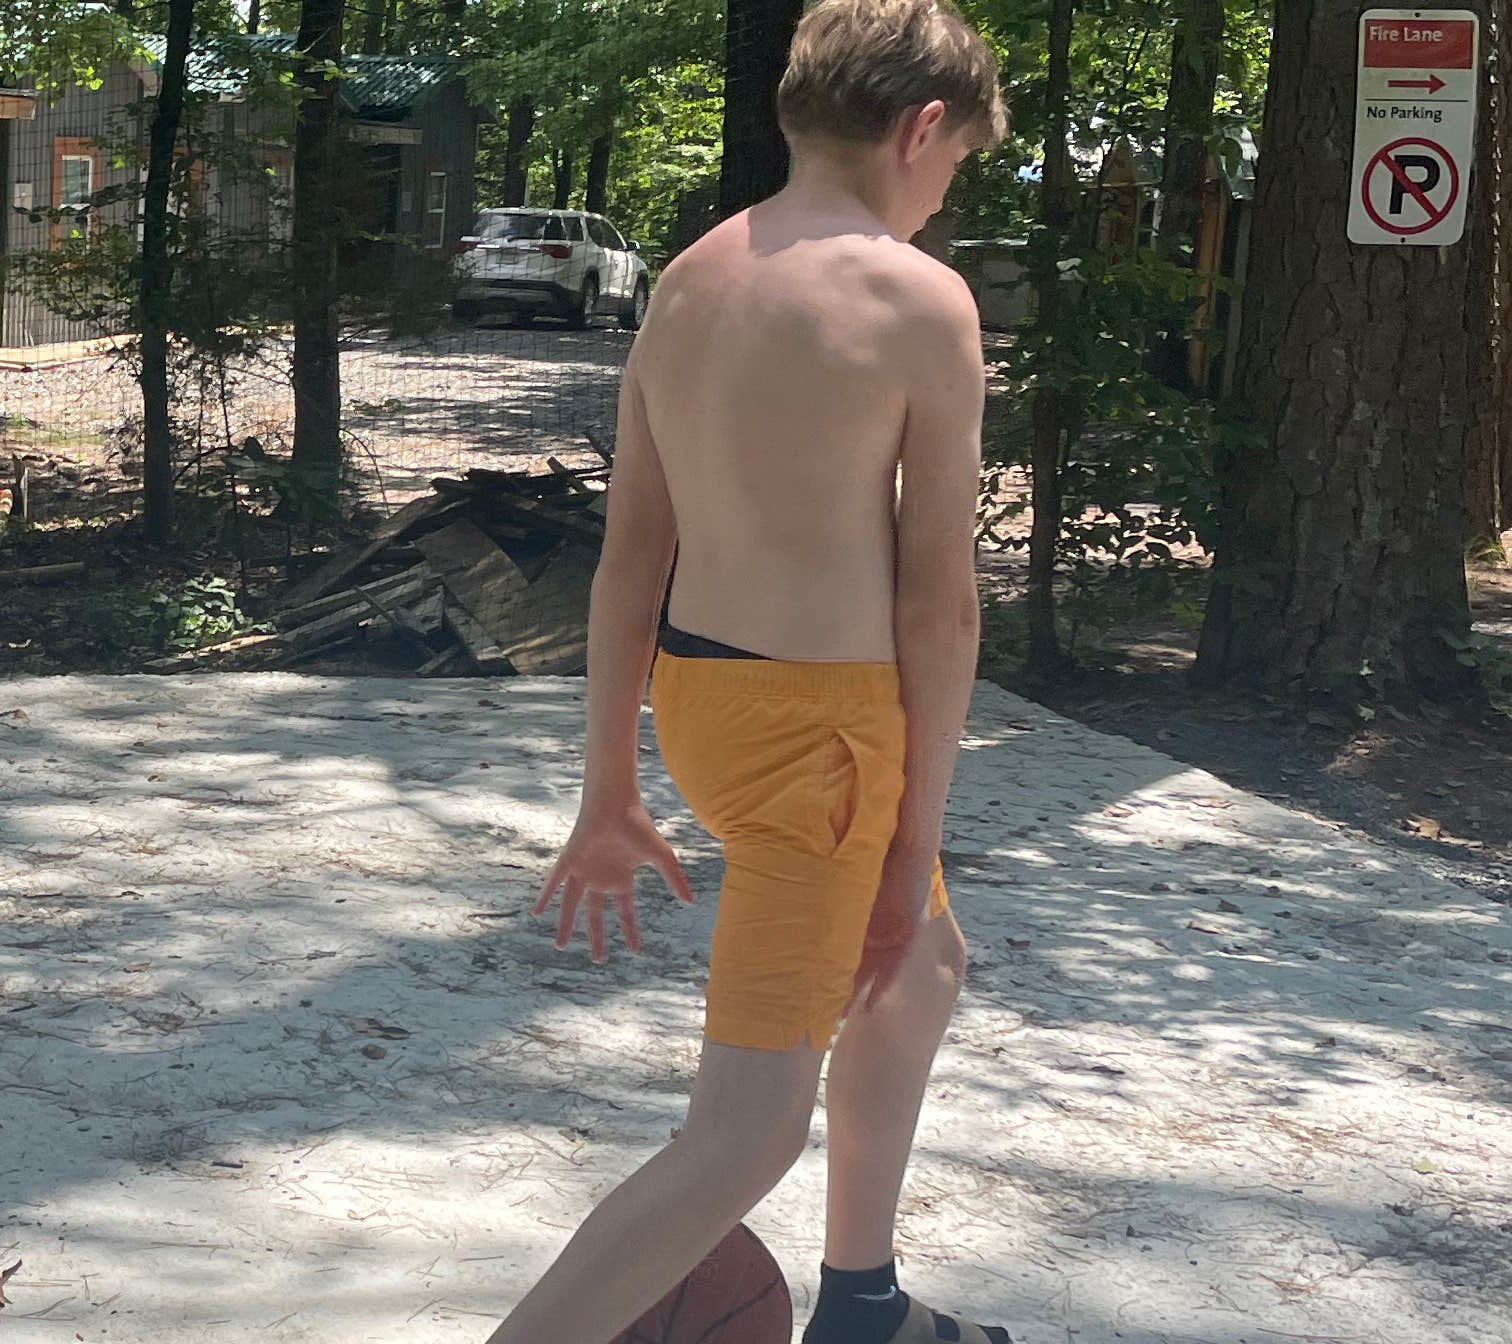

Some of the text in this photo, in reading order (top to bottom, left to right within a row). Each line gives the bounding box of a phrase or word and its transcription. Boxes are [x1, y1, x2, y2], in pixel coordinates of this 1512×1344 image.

[1369, 25, 1444, 42] Fire Lane
[1366, 105, 1443, 124] No Parking
